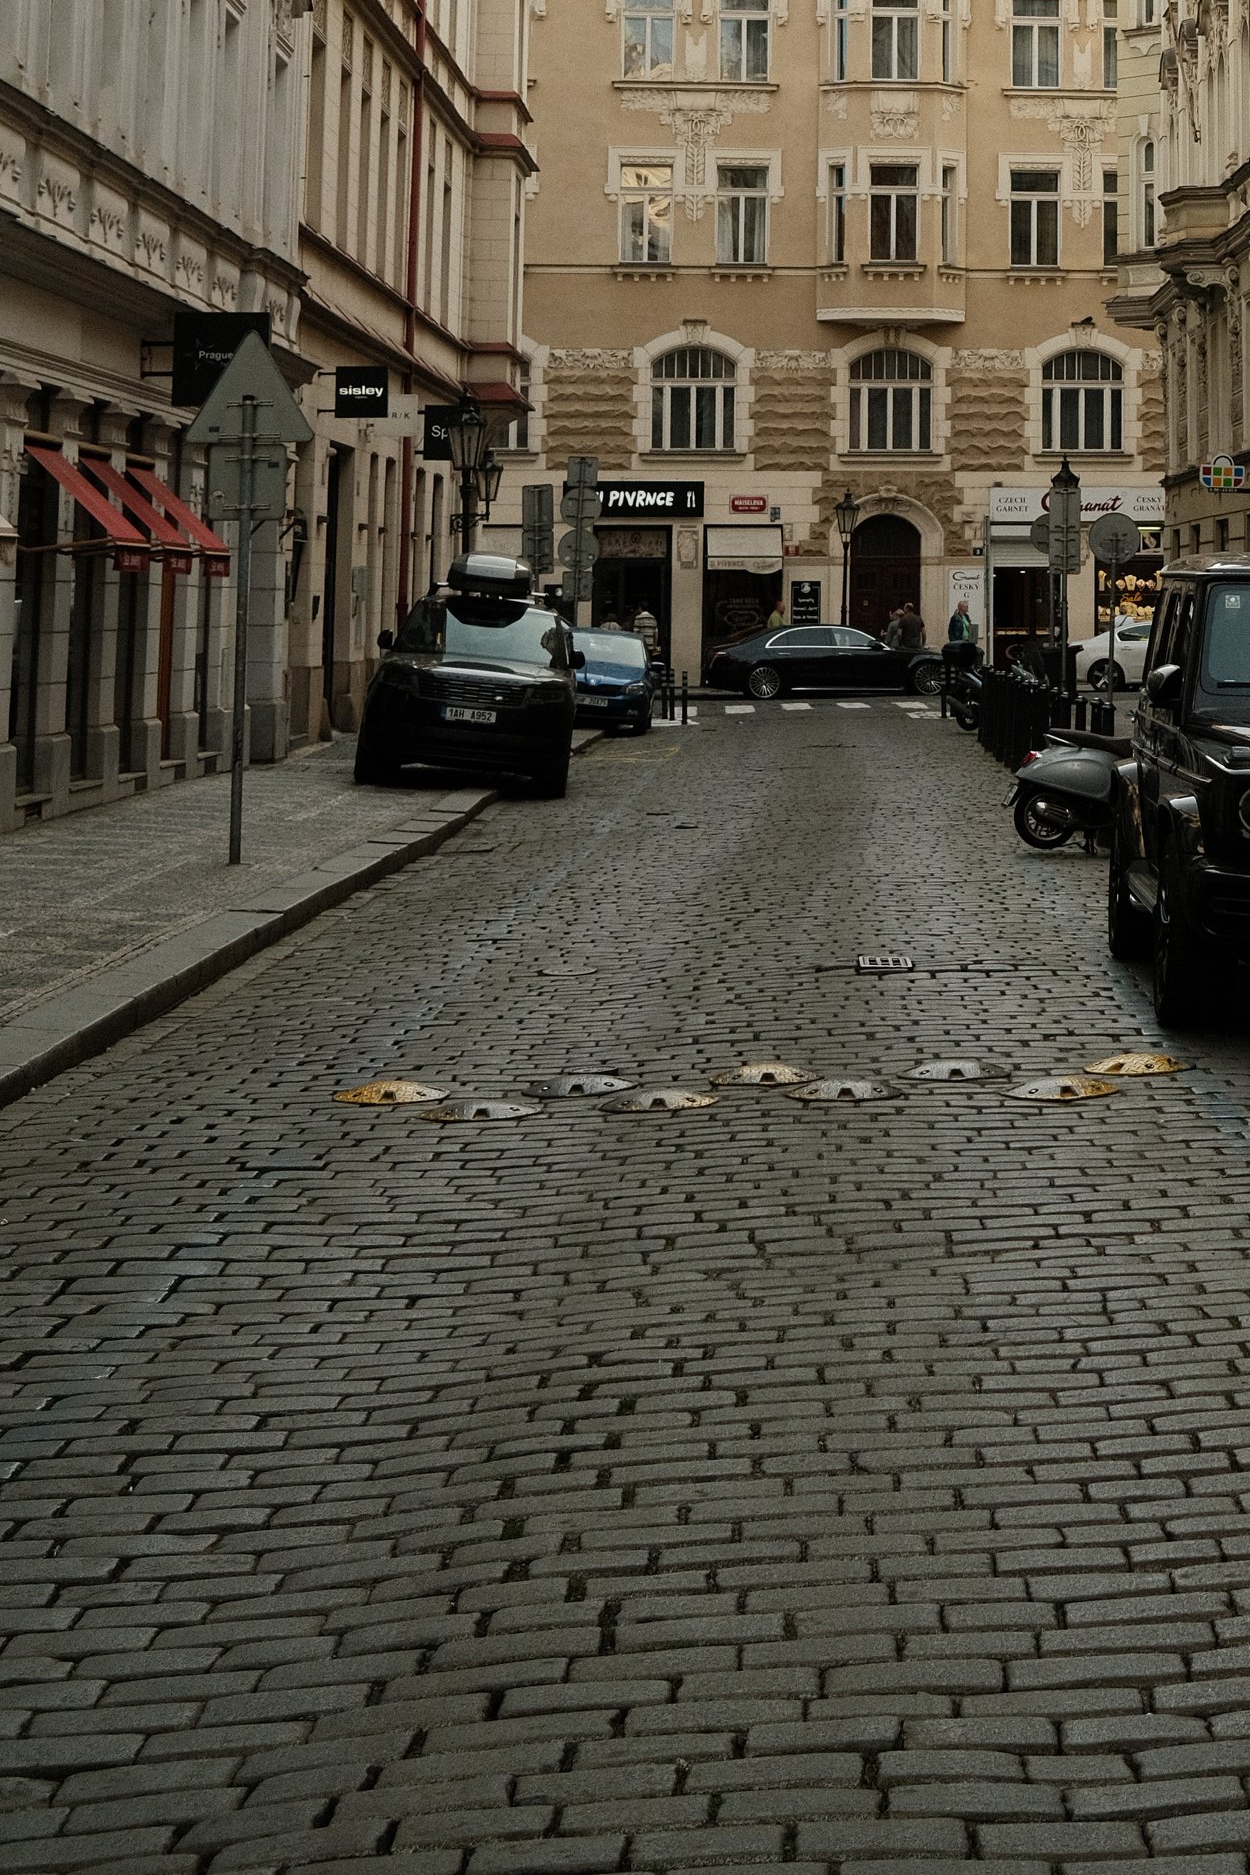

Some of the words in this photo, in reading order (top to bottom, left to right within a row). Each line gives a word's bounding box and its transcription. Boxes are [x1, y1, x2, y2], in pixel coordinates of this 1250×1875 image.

[198, 350, 234, 361] Prague
[338, 385, 384, 397] sisley
[608, 490, 675, 507] PIVRNCE
[448, 708, 465, 719] 1AH
[470, 710, 492, 722] A952
